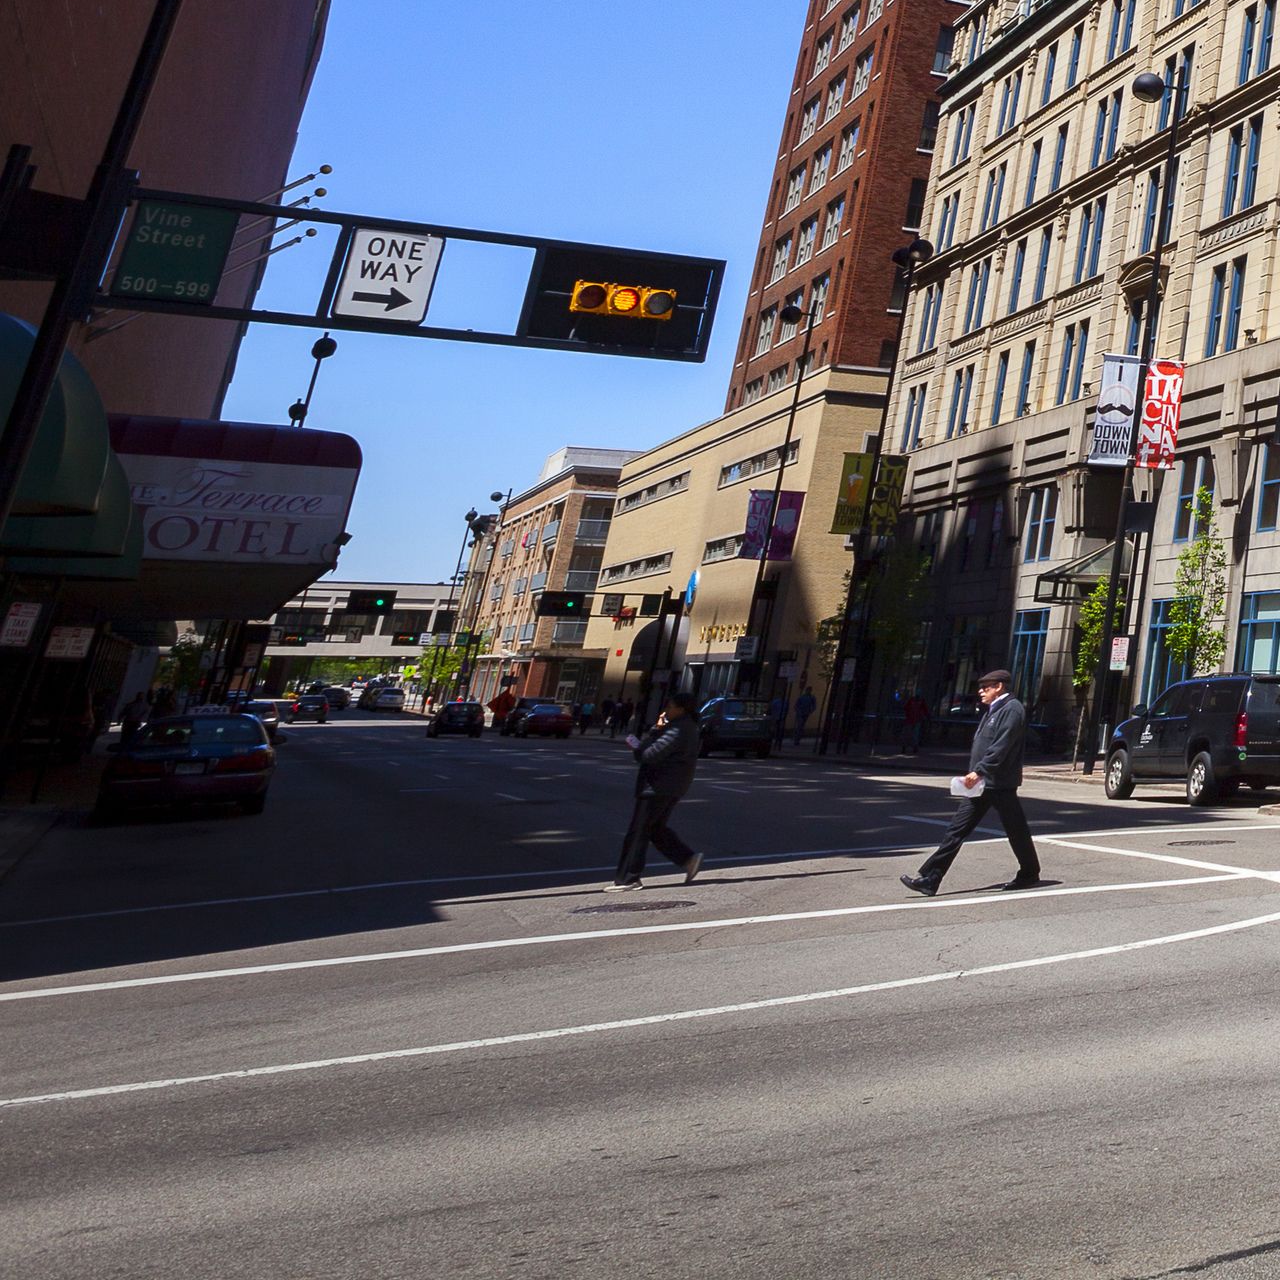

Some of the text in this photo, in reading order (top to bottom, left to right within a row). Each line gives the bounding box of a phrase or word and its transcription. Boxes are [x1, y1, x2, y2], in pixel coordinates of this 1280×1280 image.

[145, 208, 192, 227] Vine
[136, 226, 206, 248] Street
[367, 237, 426, 261] ONE
[360, 260, 423, 283] WAY
[120, 276, 209, 297] 500-599
[1094, 424, 1131, 441] DOWN
[1093, 439, 1129, 455] TOWN
[172, 468, 323, 513] Terrace
